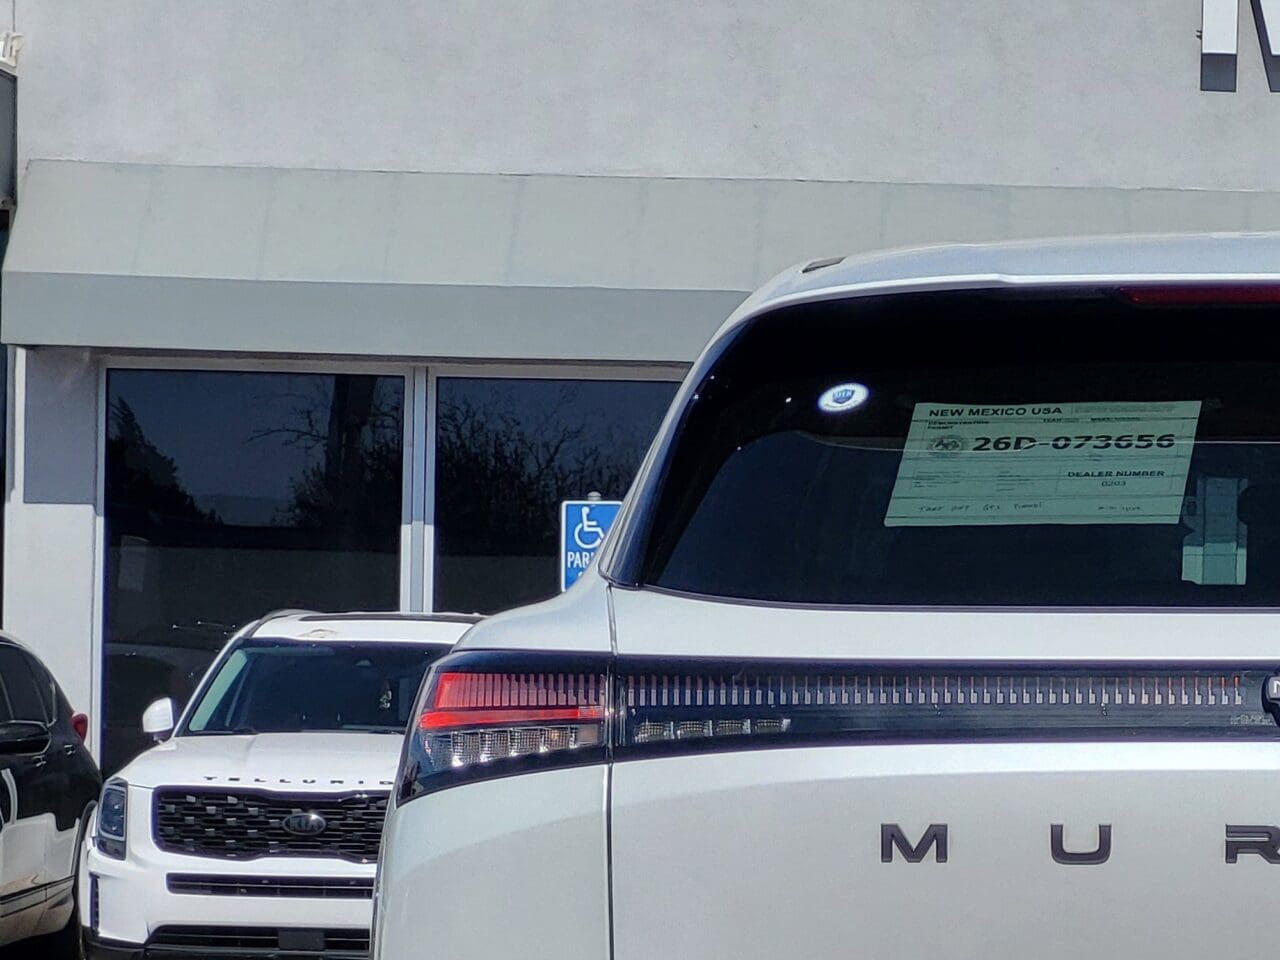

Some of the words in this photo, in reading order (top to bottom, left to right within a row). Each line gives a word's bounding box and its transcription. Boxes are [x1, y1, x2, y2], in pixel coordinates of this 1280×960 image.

[929, 408, 963, 417] NEW
[967, 407, 1027, 417] MEXICO
[1031, 406, 1063, 416] USA
[972, 434, 1176, 452] 26D-073656
[1115, 470, 1166, 478] NUMBER
